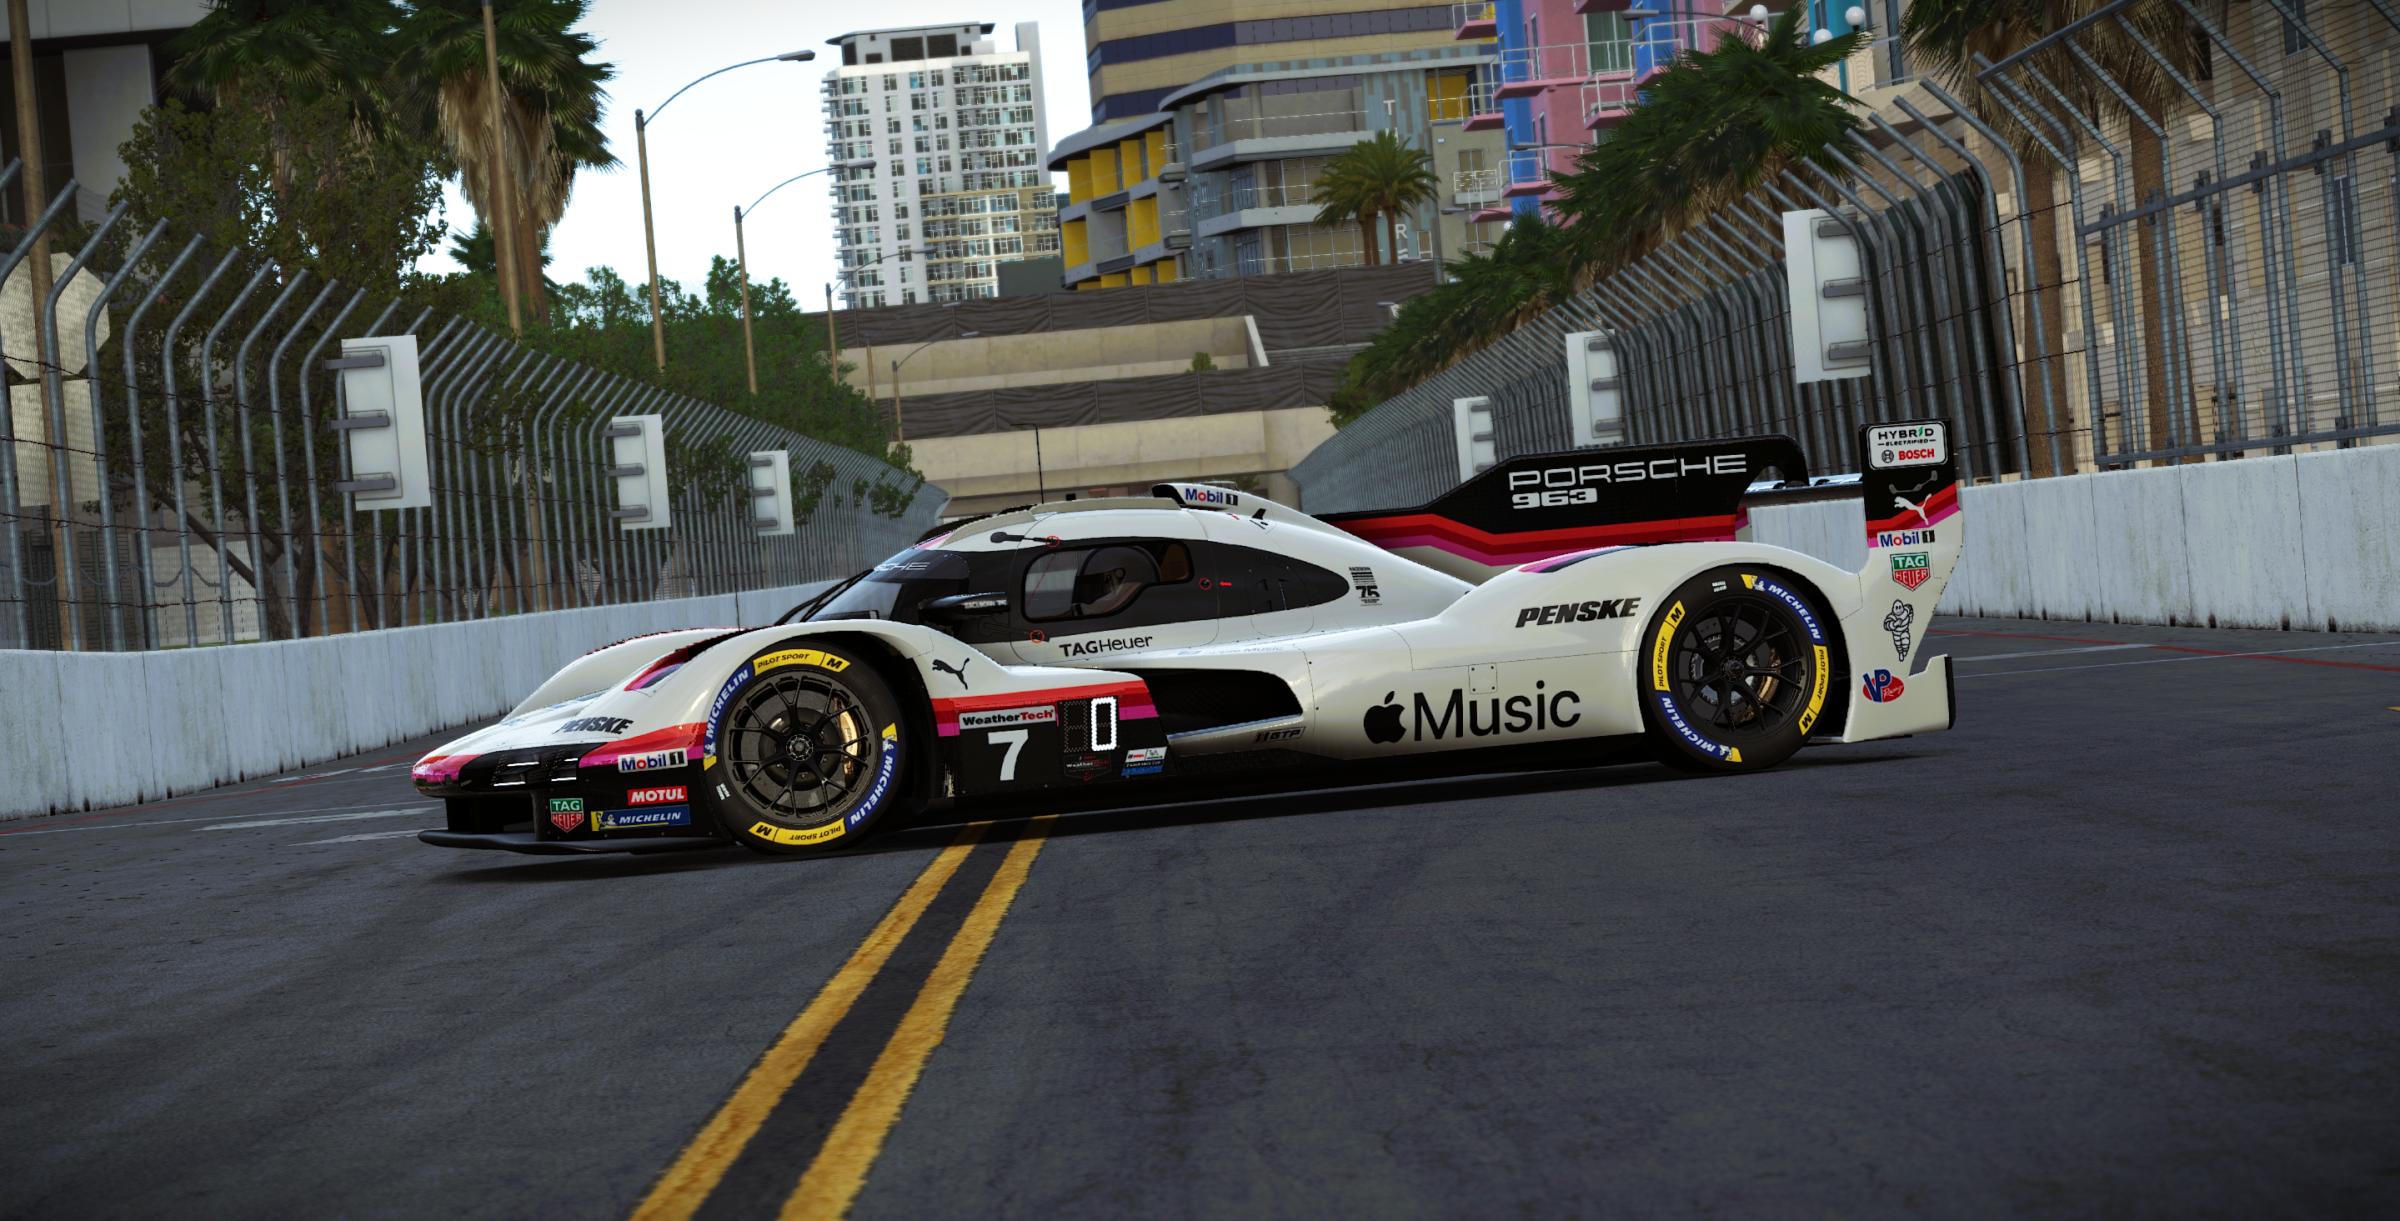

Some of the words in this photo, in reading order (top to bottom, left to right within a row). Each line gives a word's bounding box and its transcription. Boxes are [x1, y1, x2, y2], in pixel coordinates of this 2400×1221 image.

[1898, 448, 1935, 461] BOSCH
[1508, 453, 1748, 491] PORSCHE
[1185, 487, 1223, 504] Mobil
[1226, 493, 1239, 506] 1
[1511, 487, 1598, 510] 963
[1880, 531, 1920, 547] Mobil
[1922, 530, 1935, 543] 1
[1894, 555, 1925, 568] TAG
[1895, 569, 1928, 590] HEUER
[1355, 585, 1380, 598] 75
[1515, 597, 1642, 628] PENSKE
[1670, 607, 1683, 623] M
[1768, 584, 1822, 639] MICHELIN
[1658, 636, 1668, 662] SPORT
[757, 656, 780, 669] PILOT
[781, 653, 810, 662] SPORT
[826, 658, 843, 669] M
[1658, 662, 1666, 688] PILOT
[1862, 669, 1892, 703] VP
[705, 669, 749, 739] MICHELIN
[1413, 679, 1582, 741] Music
[962, 709, 1054, 727] WeatherTech
[1661, 697, 1717, 753] MICHELIN
[621, 754, 666, 771] Mobil
[669, 750, 685, 766] 1
[987, 728, 1029, 782] 7
[630, 788, 685, 803] MOTUL
[850, 755, 893, 825] MICHELIN
[552, 800, 581, 811] TAG
[552, 812, 582, 832] HEUER
[619, 812, 682, 824] MICHELIN
[756, 824, 773, 836] M
